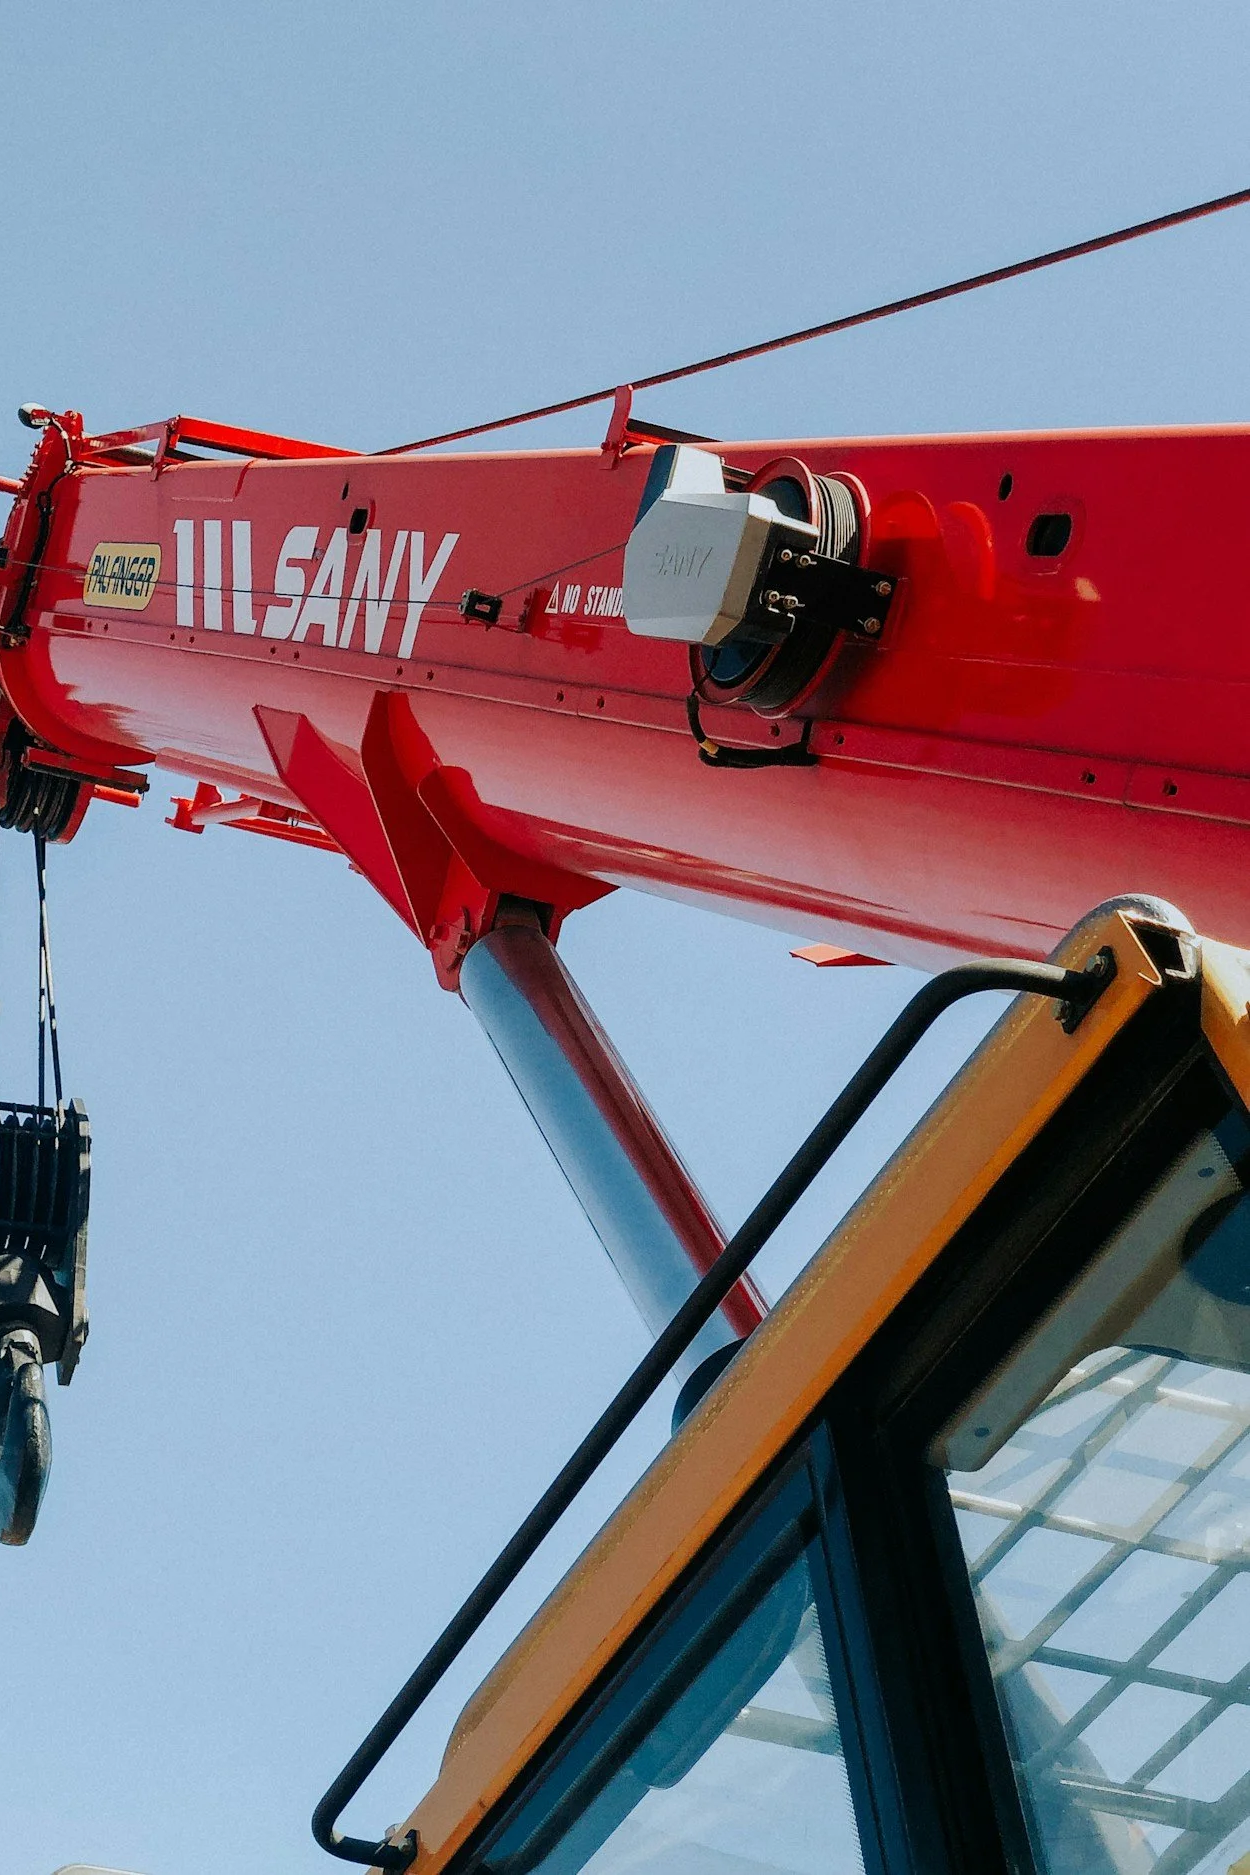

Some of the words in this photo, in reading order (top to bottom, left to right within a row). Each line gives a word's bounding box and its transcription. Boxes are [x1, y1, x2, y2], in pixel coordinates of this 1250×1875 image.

[87, 555, 156, 597] PALFINGER
[261, 526, 460, 659] SANY
[561, 584, 581, 614] NO
[584, 585, 624, 617] STAND
